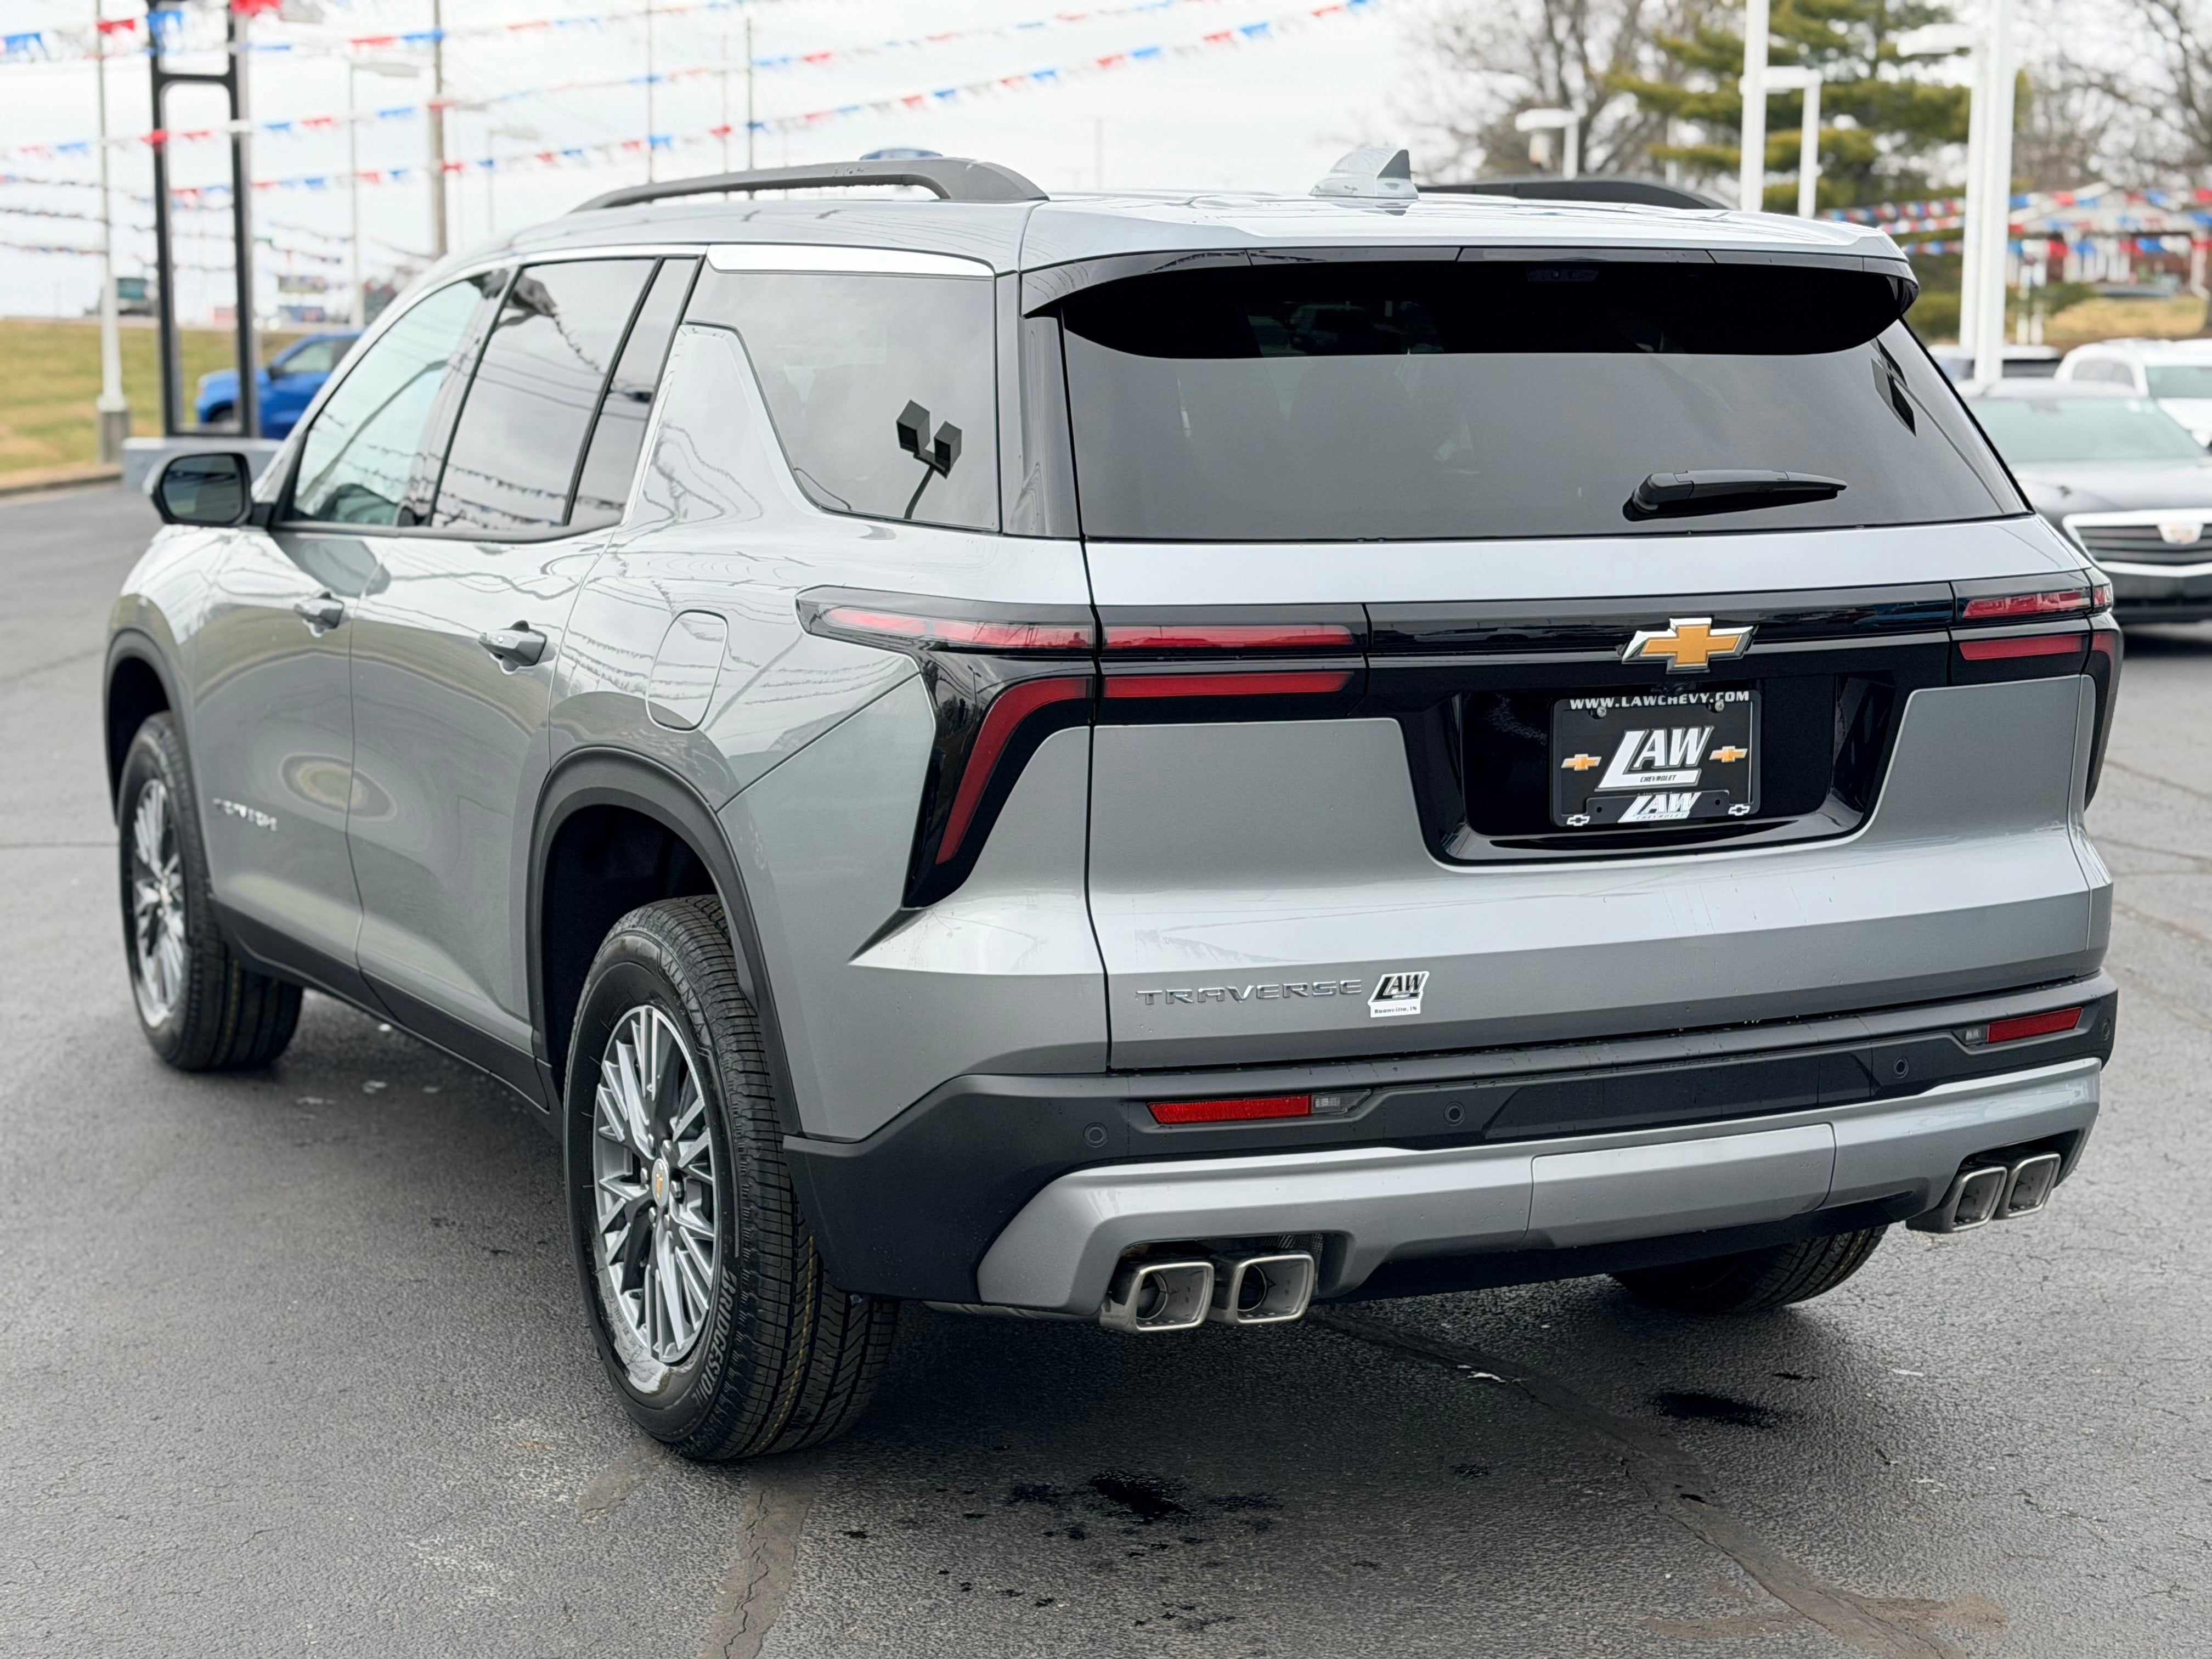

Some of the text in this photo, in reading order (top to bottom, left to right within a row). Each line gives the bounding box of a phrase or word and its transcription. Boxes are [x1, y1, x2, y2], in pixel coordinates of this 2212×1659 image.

[1570, 690, 1749, 709] WWW.LAWCHEVY.COM
[1595, 725, 1714, 792] LAW
[1640, 774, 1677, 783] CHEVROLET
[1618, 792, 1702, 823] LAW
[1136, 979, 1362, 1005] TRAVERSE
[1372, 973, 1426, 1002] LAW
